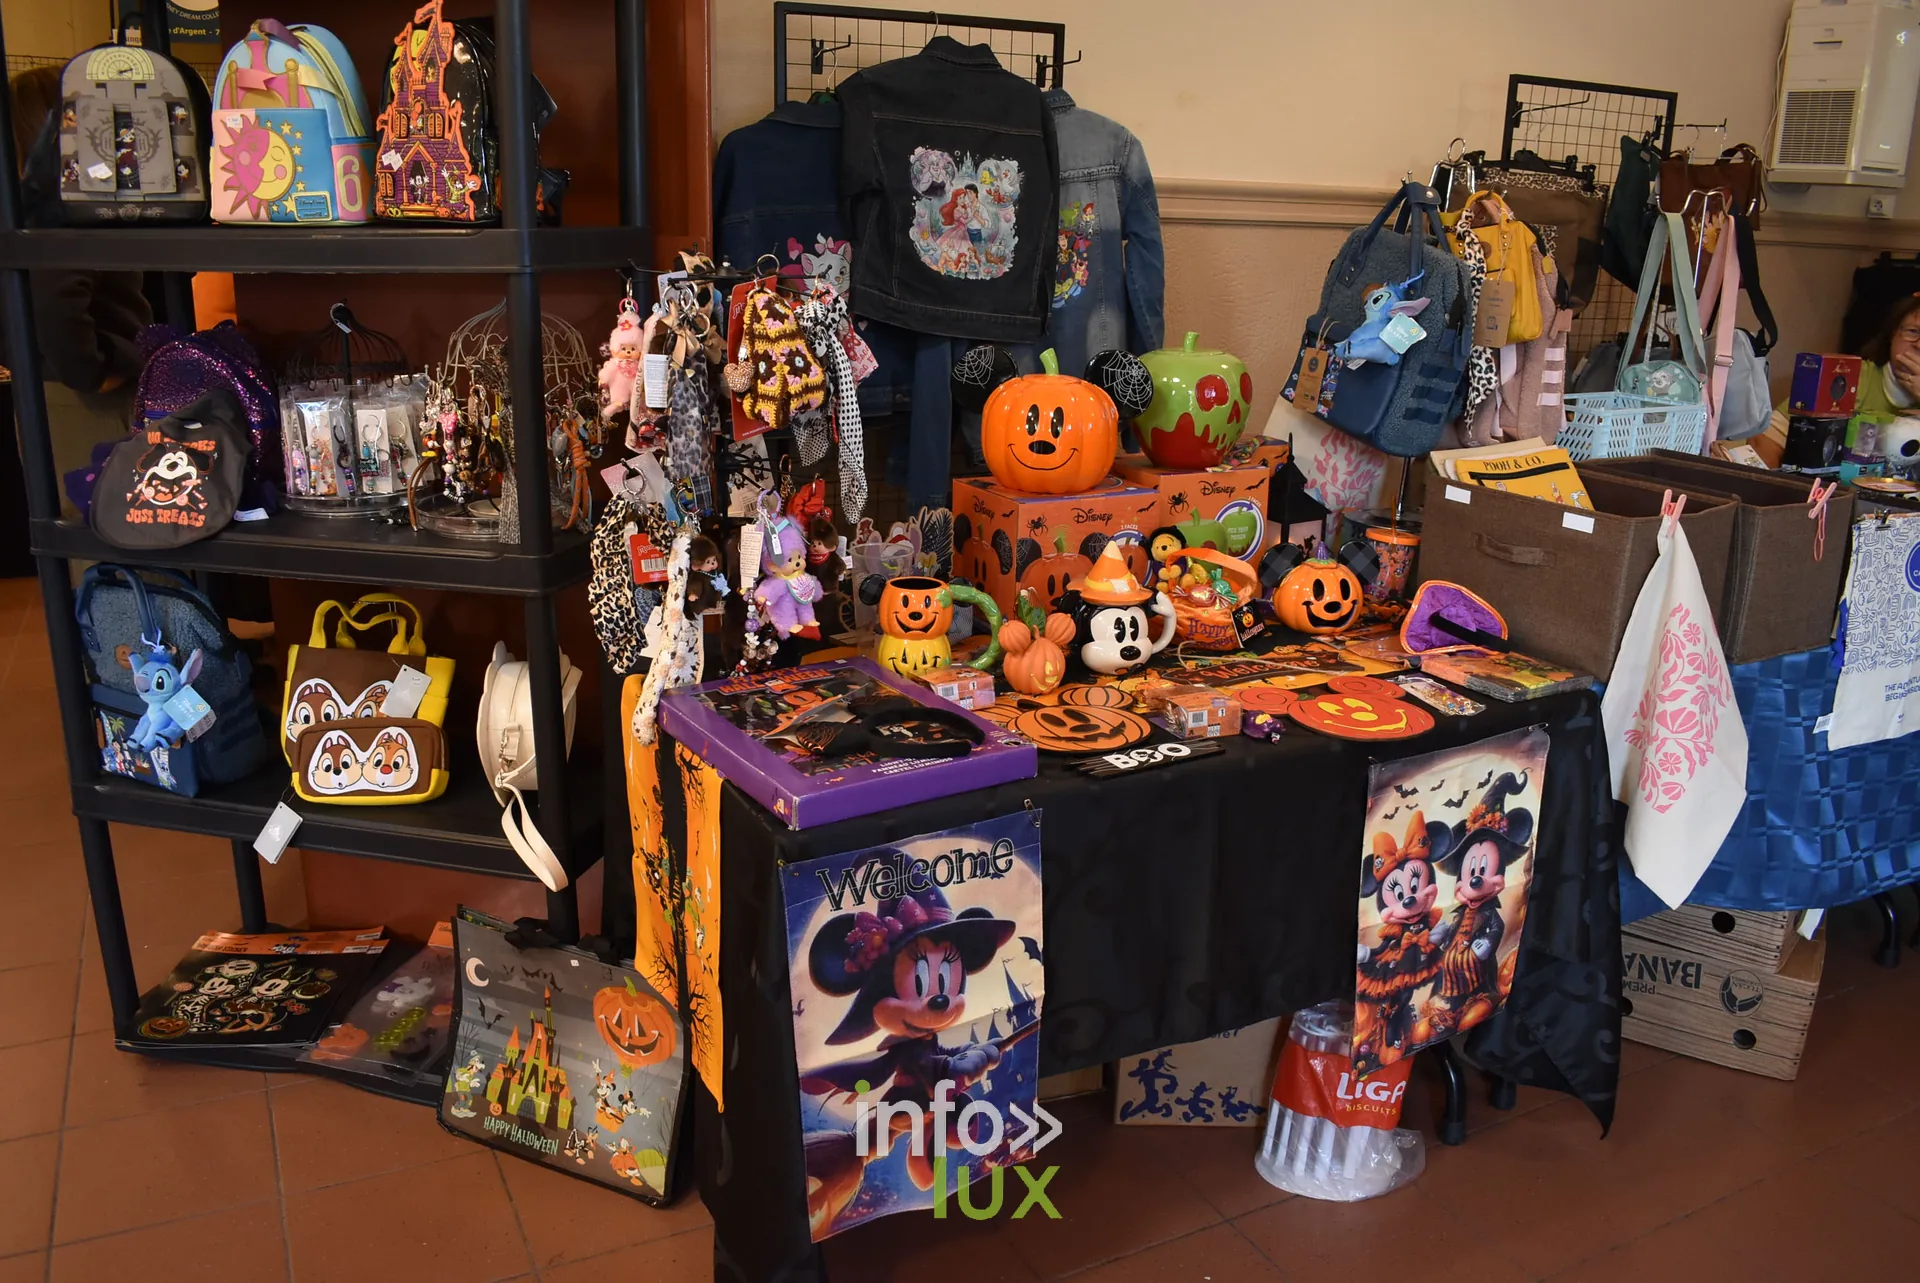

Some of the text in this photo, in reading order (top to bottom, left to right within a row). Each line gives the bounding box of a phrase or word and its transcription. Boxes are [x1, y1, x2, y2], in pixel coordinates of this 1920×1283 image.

[172, 27, 206, 36] d'Argent
[336, 155, 363, 212] 6
[1483, 455, 1545, 471] POOH & CO.
[126, 509, 206, 528] JUST TREATS
[1102, 743, 1192, 769] BOO
[816, 837, 1015, 912] Welcome
[1346, 1102, 1397, 1116] BISCUITS
[483, 1115, 560, 1156] HAPPY HALLOWEEN
